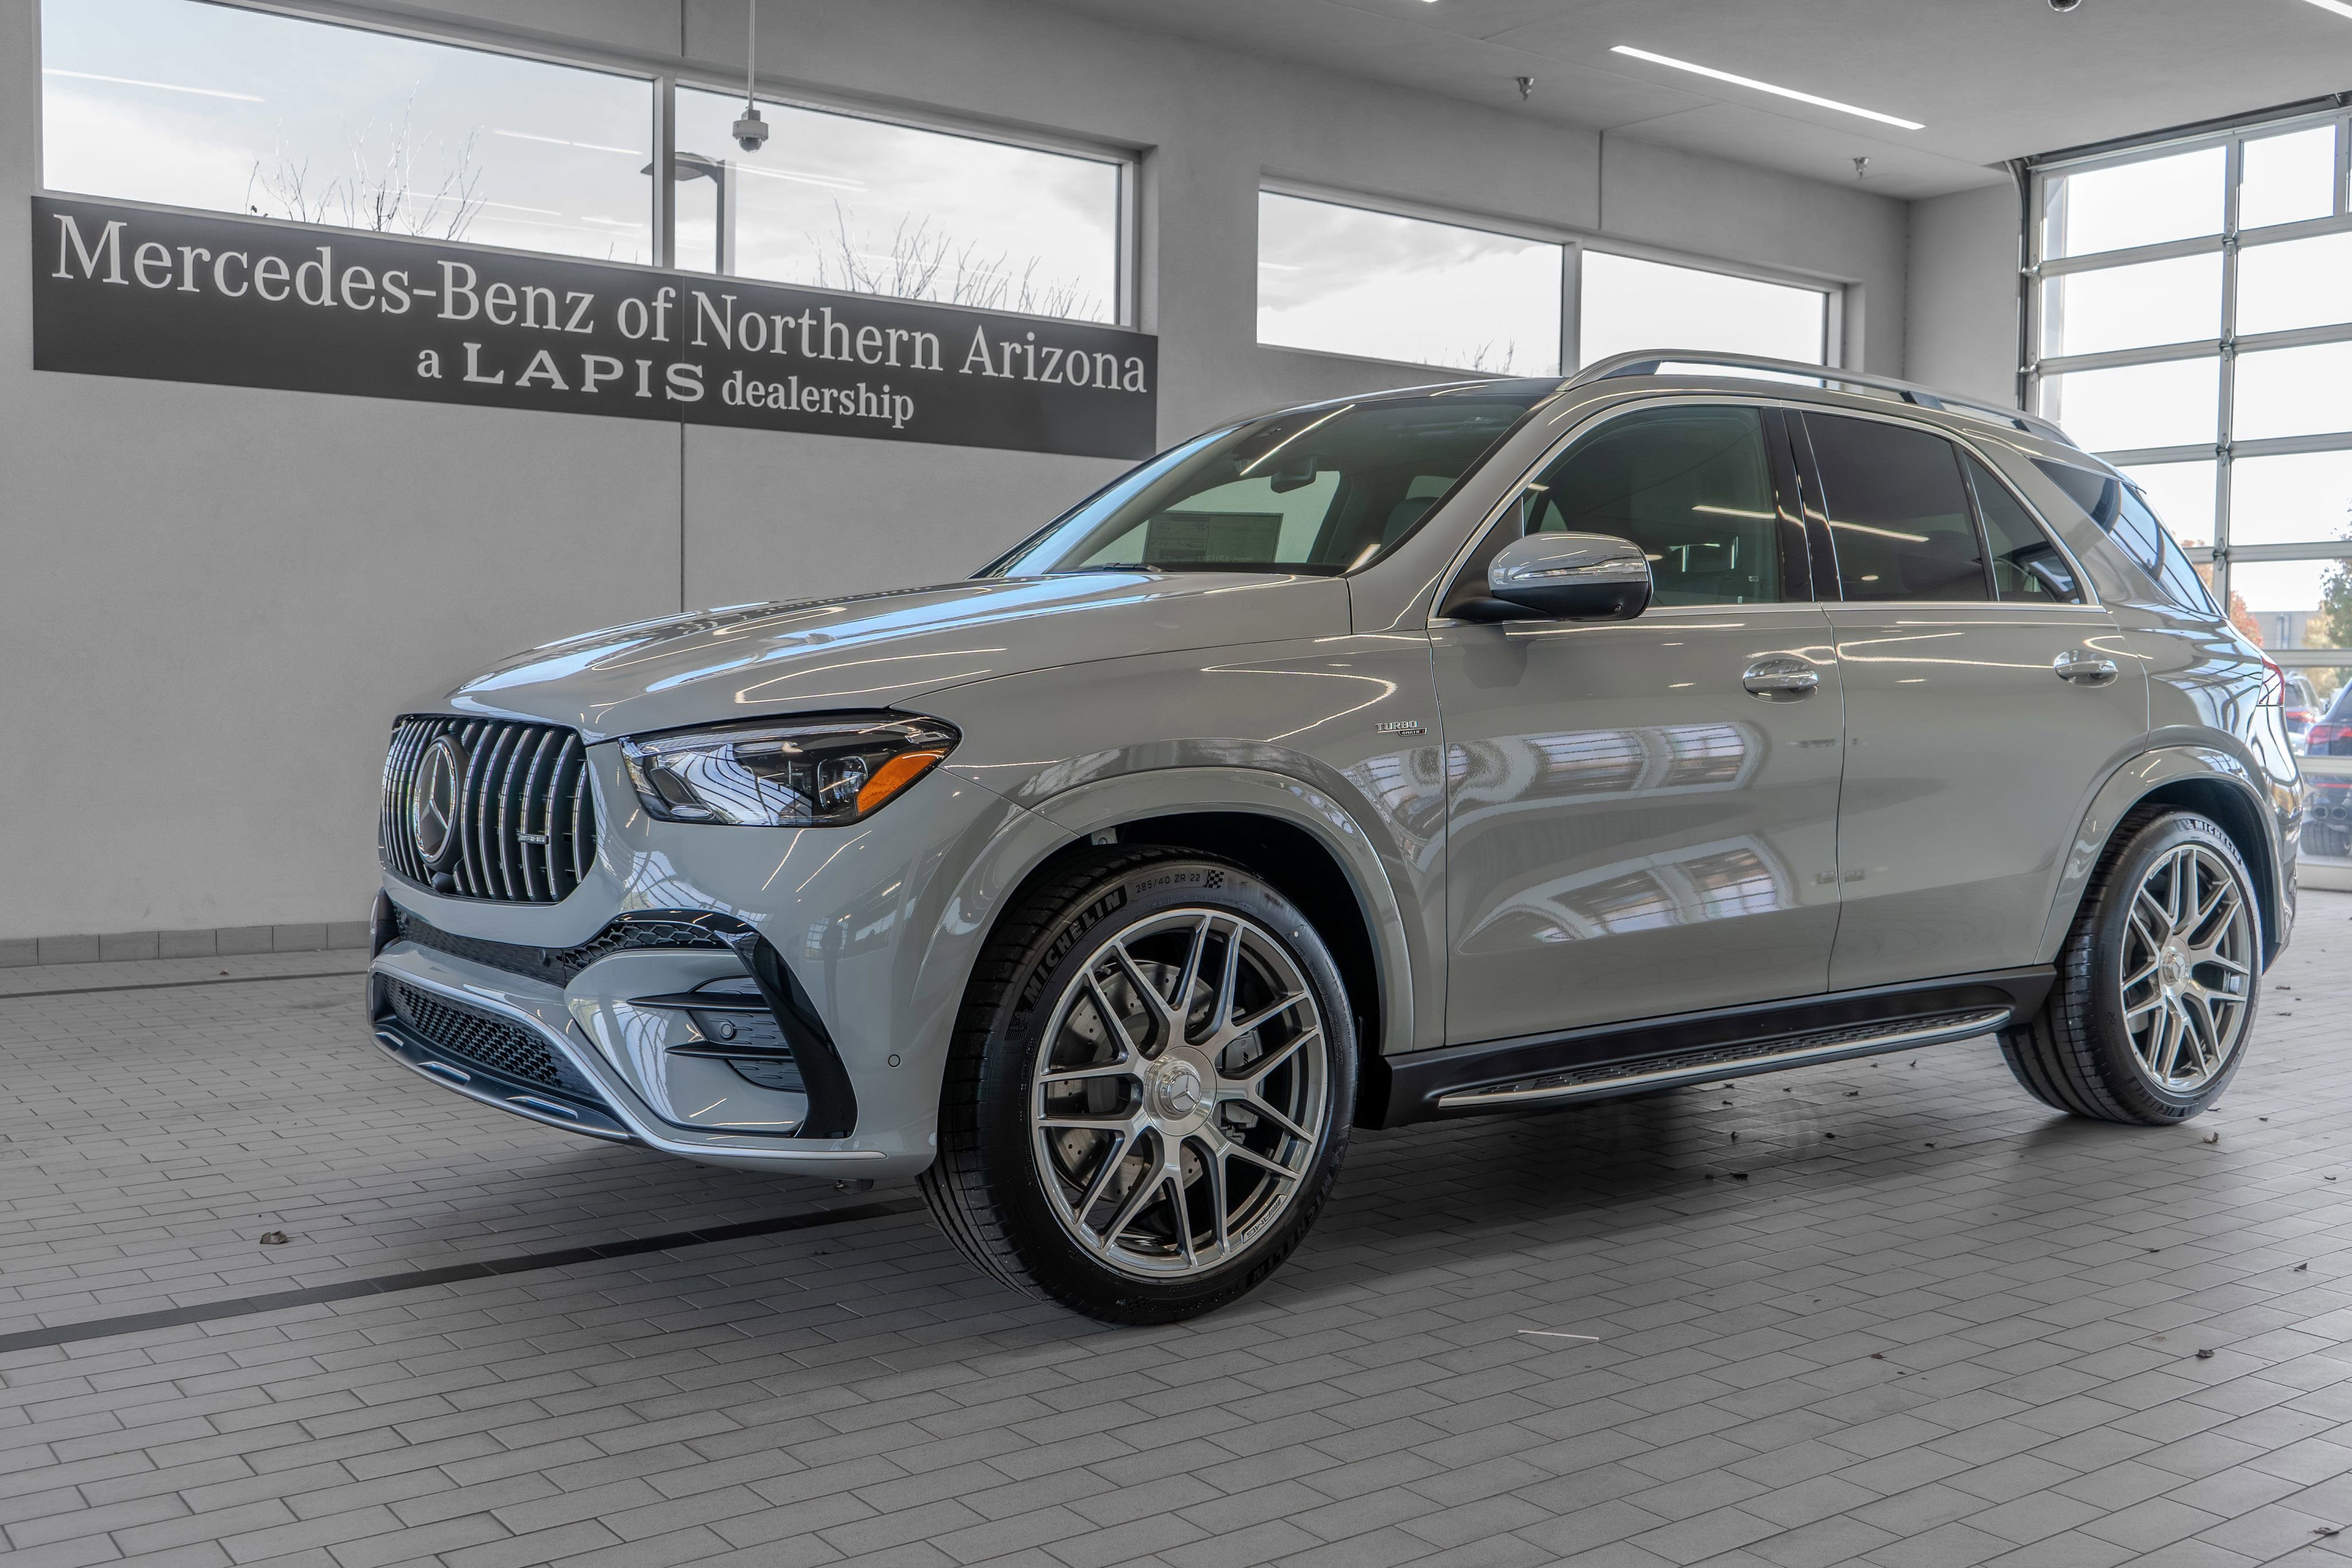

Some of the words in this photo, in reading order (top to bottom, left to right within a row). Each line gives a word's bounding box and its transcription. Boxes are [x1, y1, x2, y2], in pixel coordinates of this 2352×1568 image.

[52, 214, 595, 334] Mercedes-Benz
[617, 287, 676, 342] of
[691, 291, 943, 371] Northern
[959, 325, 1147, 393] Arizona
[417, 349, 443, 379] a
[463, 342, 705, 402] LAPIS
[722, 370, 914, 429] dealership
[1375, 720, 1418, 731] TURBO
[1135, 876, 1171, 893] 285/40
[1174, 874, 1186, 882] ZR
[1189, 873, 1201, 882] 22
[1023, 891, 1120, 1005] MICHELIN
[1246, 1209, 1274, 1238] AMG
[1252, 1172, 1333, 1283] MICHELIN
